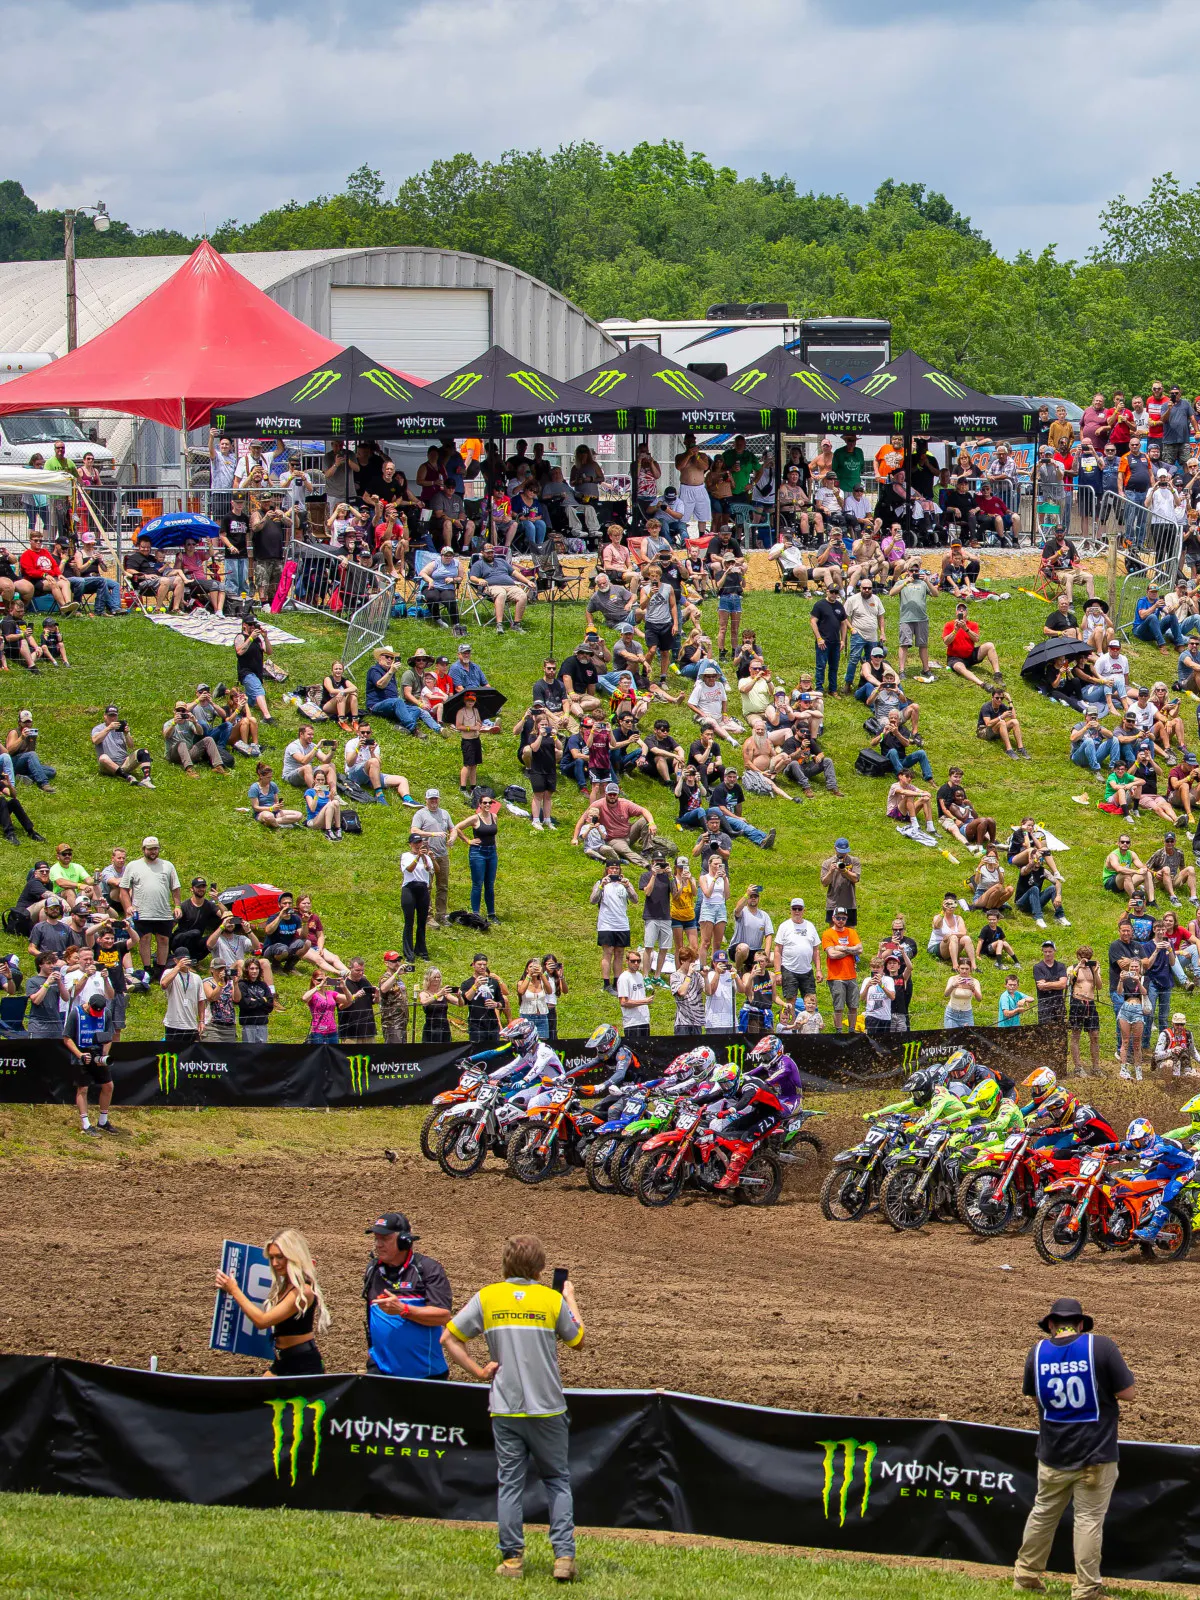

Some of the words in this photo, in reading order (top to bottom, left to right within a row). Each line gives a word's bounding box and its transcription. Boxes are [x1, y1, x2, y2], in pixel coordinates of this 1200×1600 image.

[255, 415, 302, 429] MONSTER
[397, 416, 446, 429] MONSTER
[538, 413, 592, 426] MONSTER
[682, 410, 736, 423] MONSTER
[820, 411, 871, 424] MONSTER
[953, 415, 998, 426] MONSTER
[179, 1060, 228, 1073] MONSTER
[371, 1062, 421, 1074] MONSTER
[757, 1115, 775, 1133] FLY
[492, 1311, 547, 1321] MOTOCROSS
[1040, 1360, 1089, 1376] PRESS
[1046, 1376, 1086, 1409] 30
[330, 1416, 467, 1446] MONSTER
[351, 1444, 446, 1459] ENERGY
[881, 1459, 1017, 1493] MONSTER
[900, 1488, 995, 1505] ENERGY
